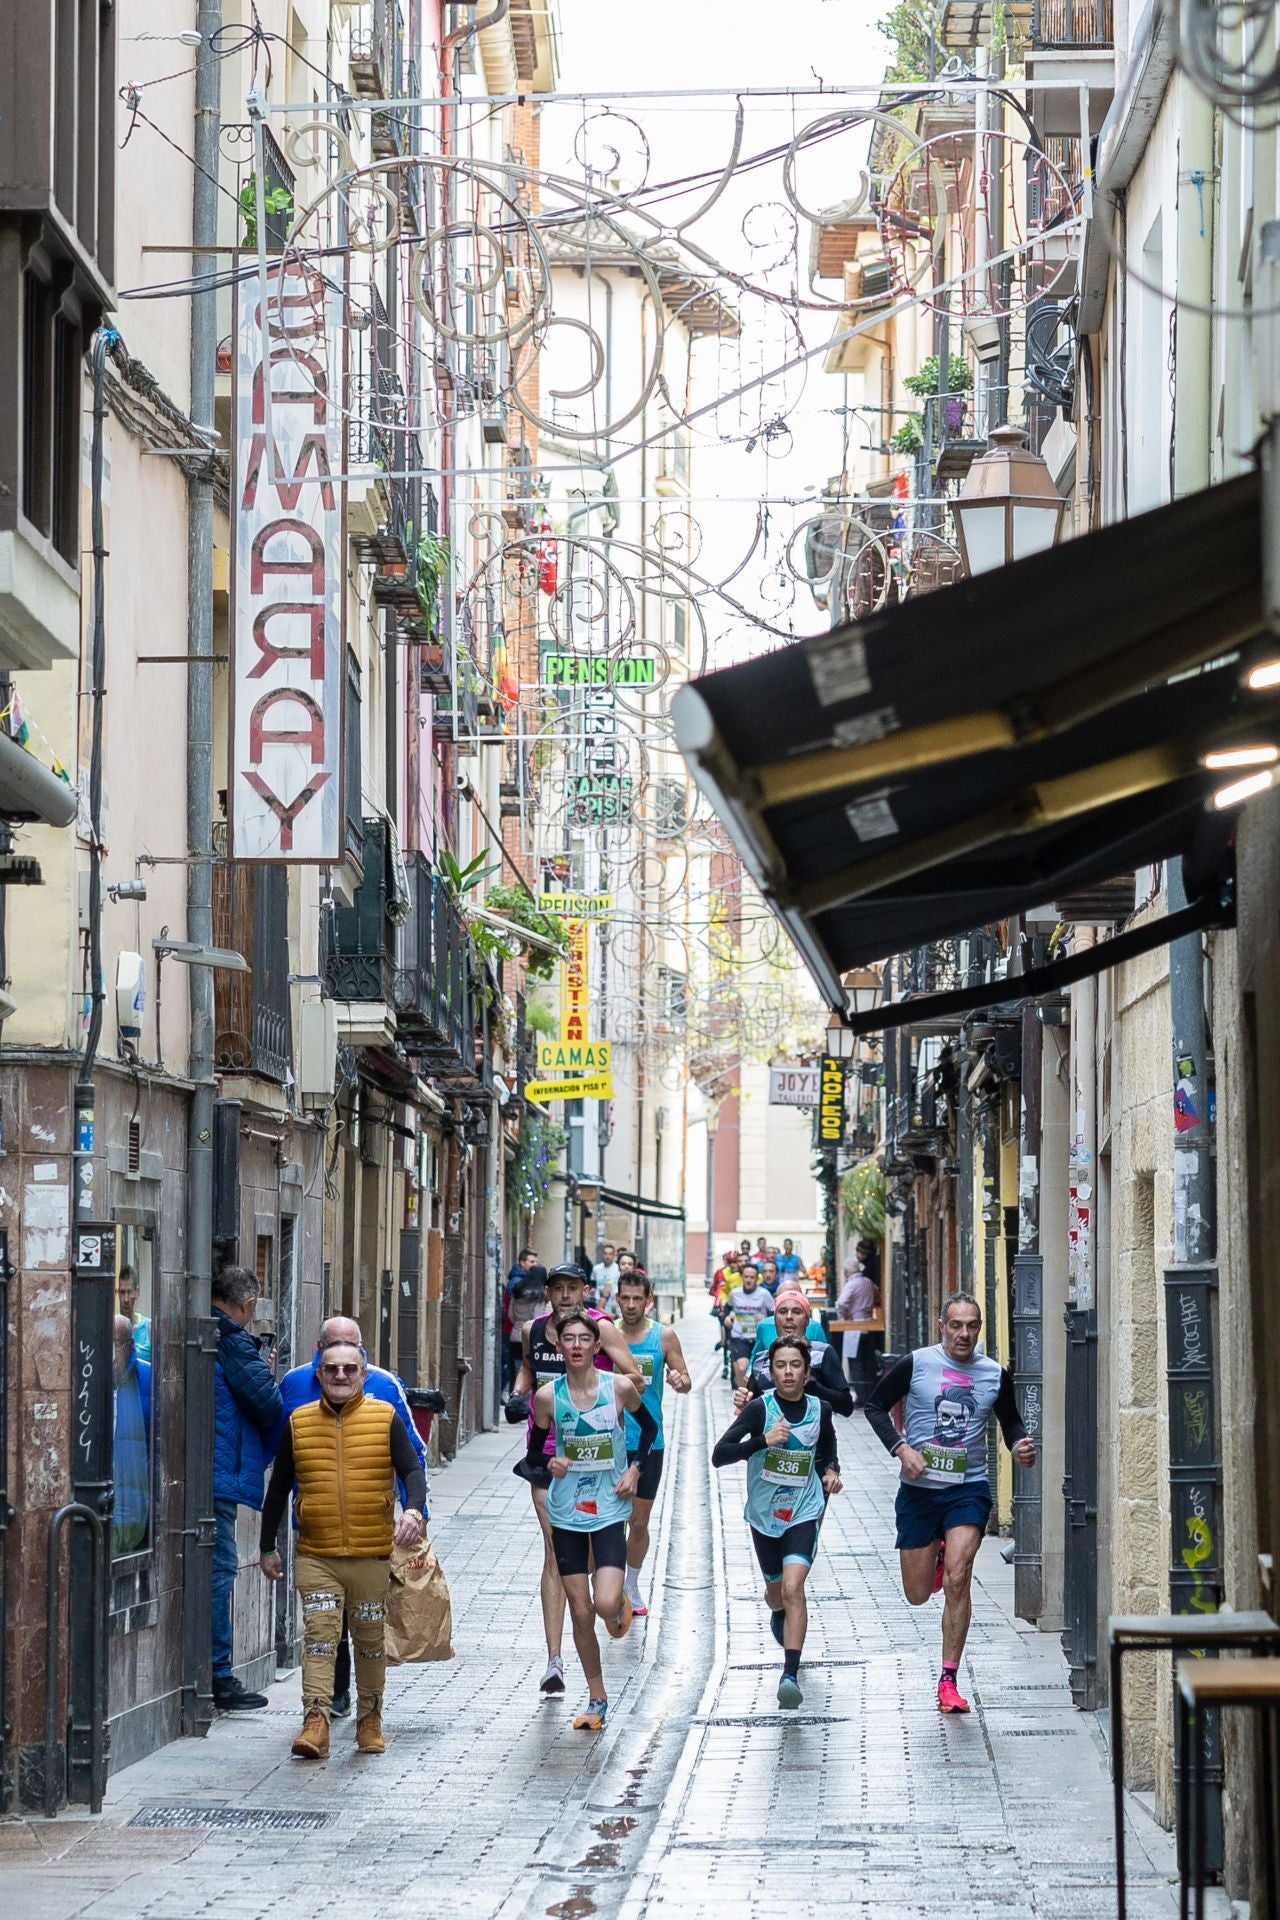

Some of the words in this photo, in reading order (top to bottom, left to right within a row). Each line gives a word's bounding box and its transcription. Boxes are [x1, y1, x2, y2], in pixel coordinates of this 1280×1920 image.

[542, 1047, 608, 1066] CAMAS
[533, 1084, 580, 1095] INFORMACIÓN
[583, 1082, 599, 1091] PISO
[821, 1059, 843, 1139] TROFEOS
[576, 1446, 599, 1459] 237
[776, 1460, 800, 1474] 336
[931, 1456, 954, 1470] 318
